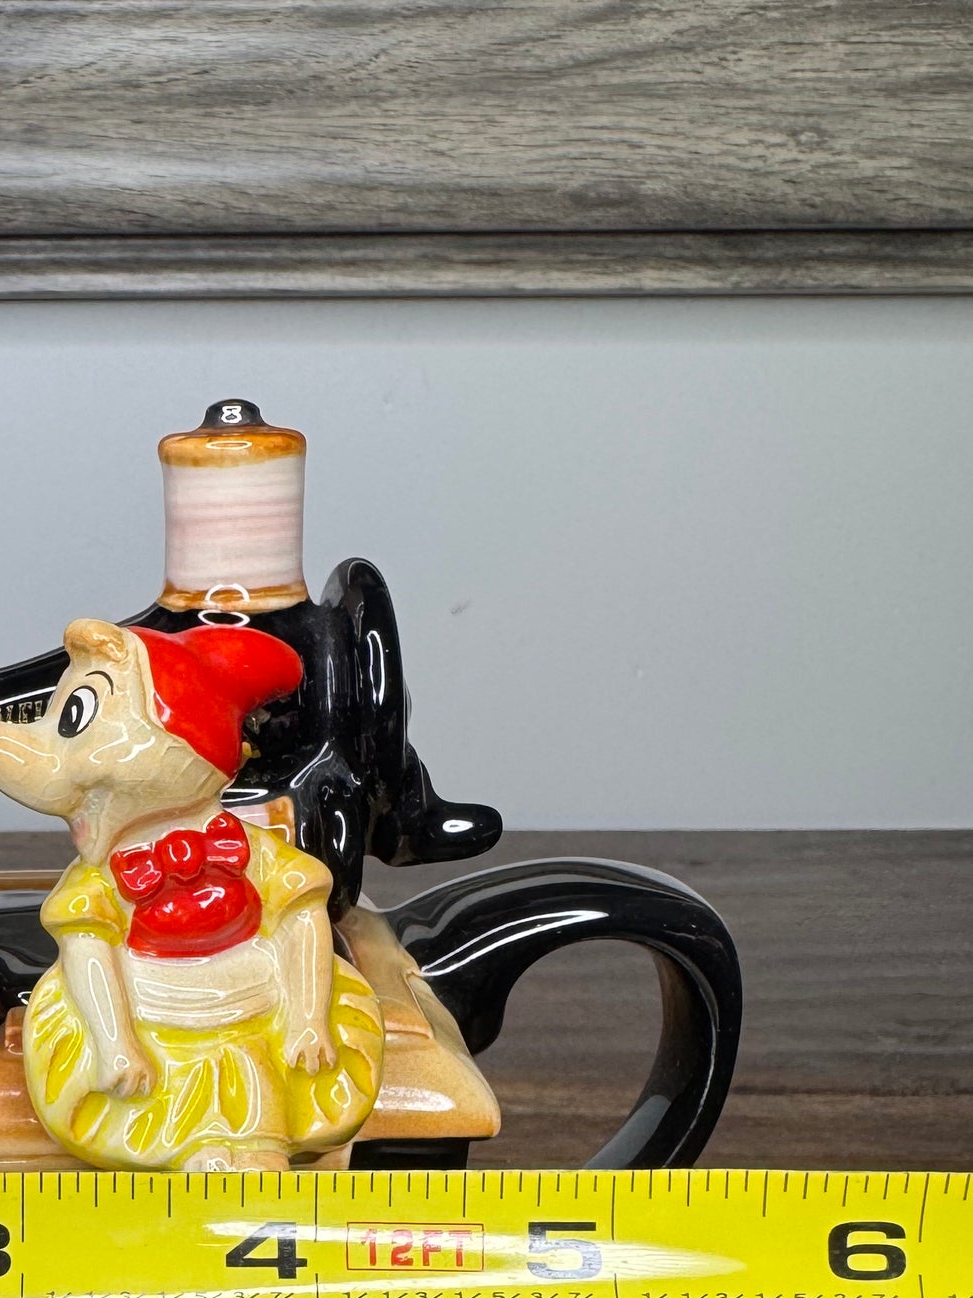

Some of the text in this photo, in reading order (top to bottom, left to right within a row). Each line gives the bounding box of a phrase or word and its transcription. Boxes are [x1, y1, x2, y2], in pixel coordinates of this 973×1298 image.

[225, 1220, 308, 1280] 4
[526, 1221, 603, 1280] 5
[827, 1220, 907, 1281] 6
